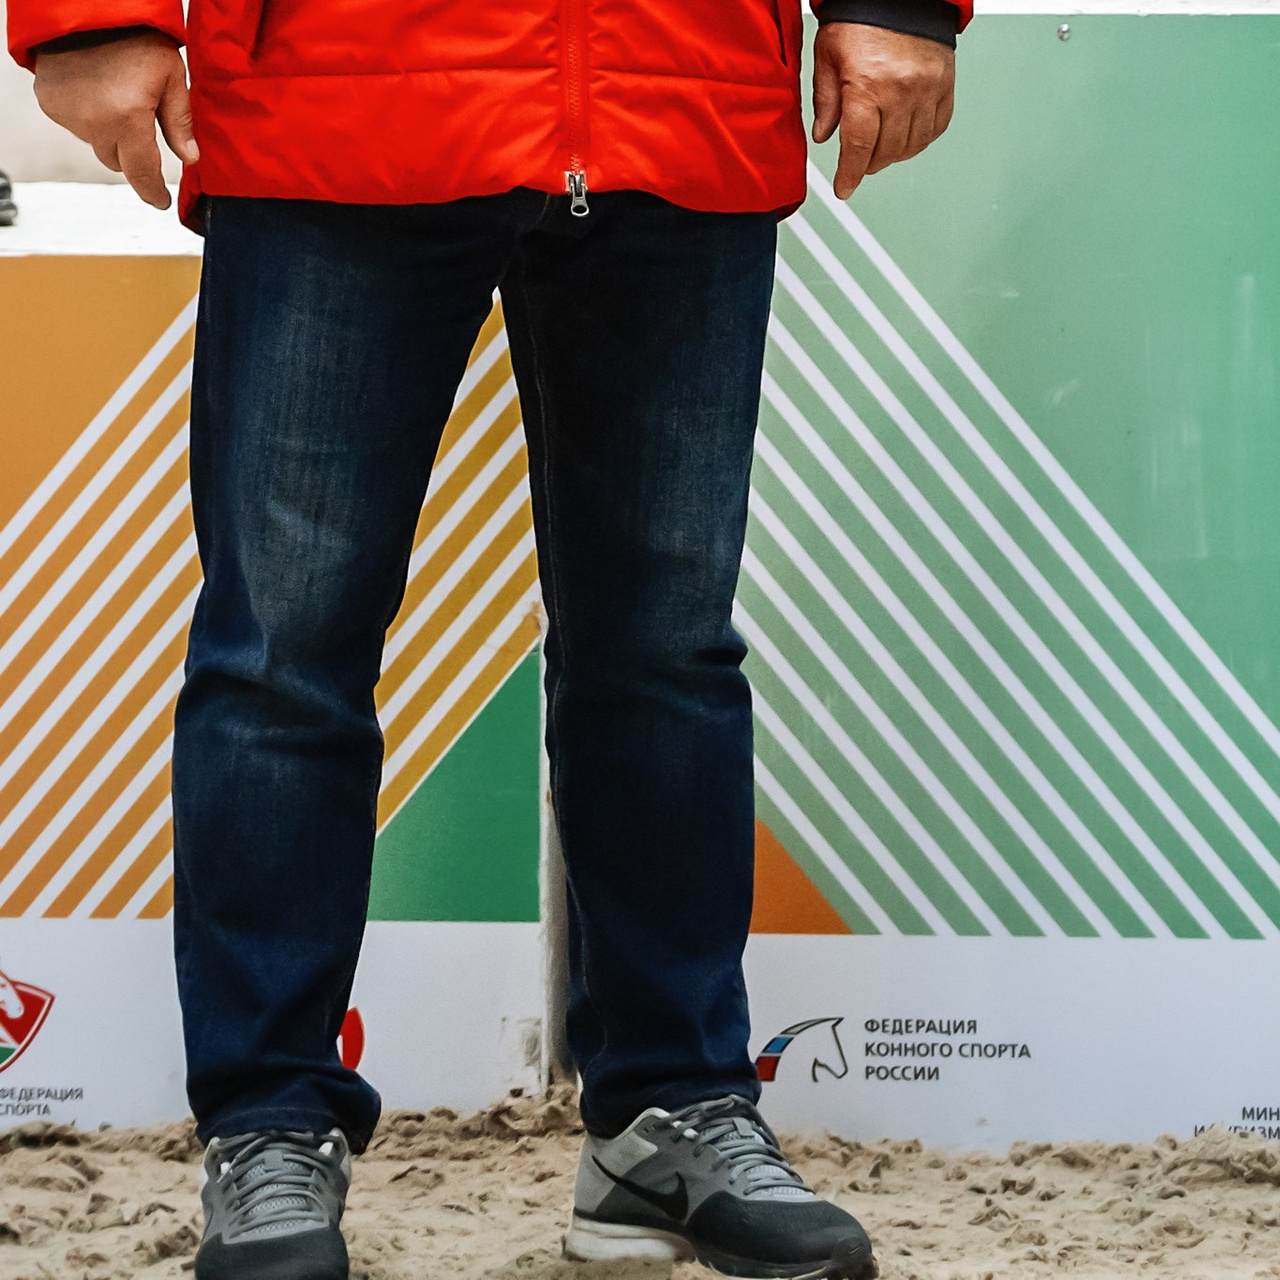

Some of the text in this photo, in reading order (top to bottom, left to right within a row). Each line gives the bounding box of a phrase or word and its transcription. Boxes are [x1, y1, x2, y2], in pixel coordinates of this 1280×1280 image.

[864, 1018, 978, 1036] ФЕДЕРАЦИЯ
[864, 1042, 1032, 1058] КОННОГО СПОРТА
[864, 1065, 940, 1081] РОССИИ
